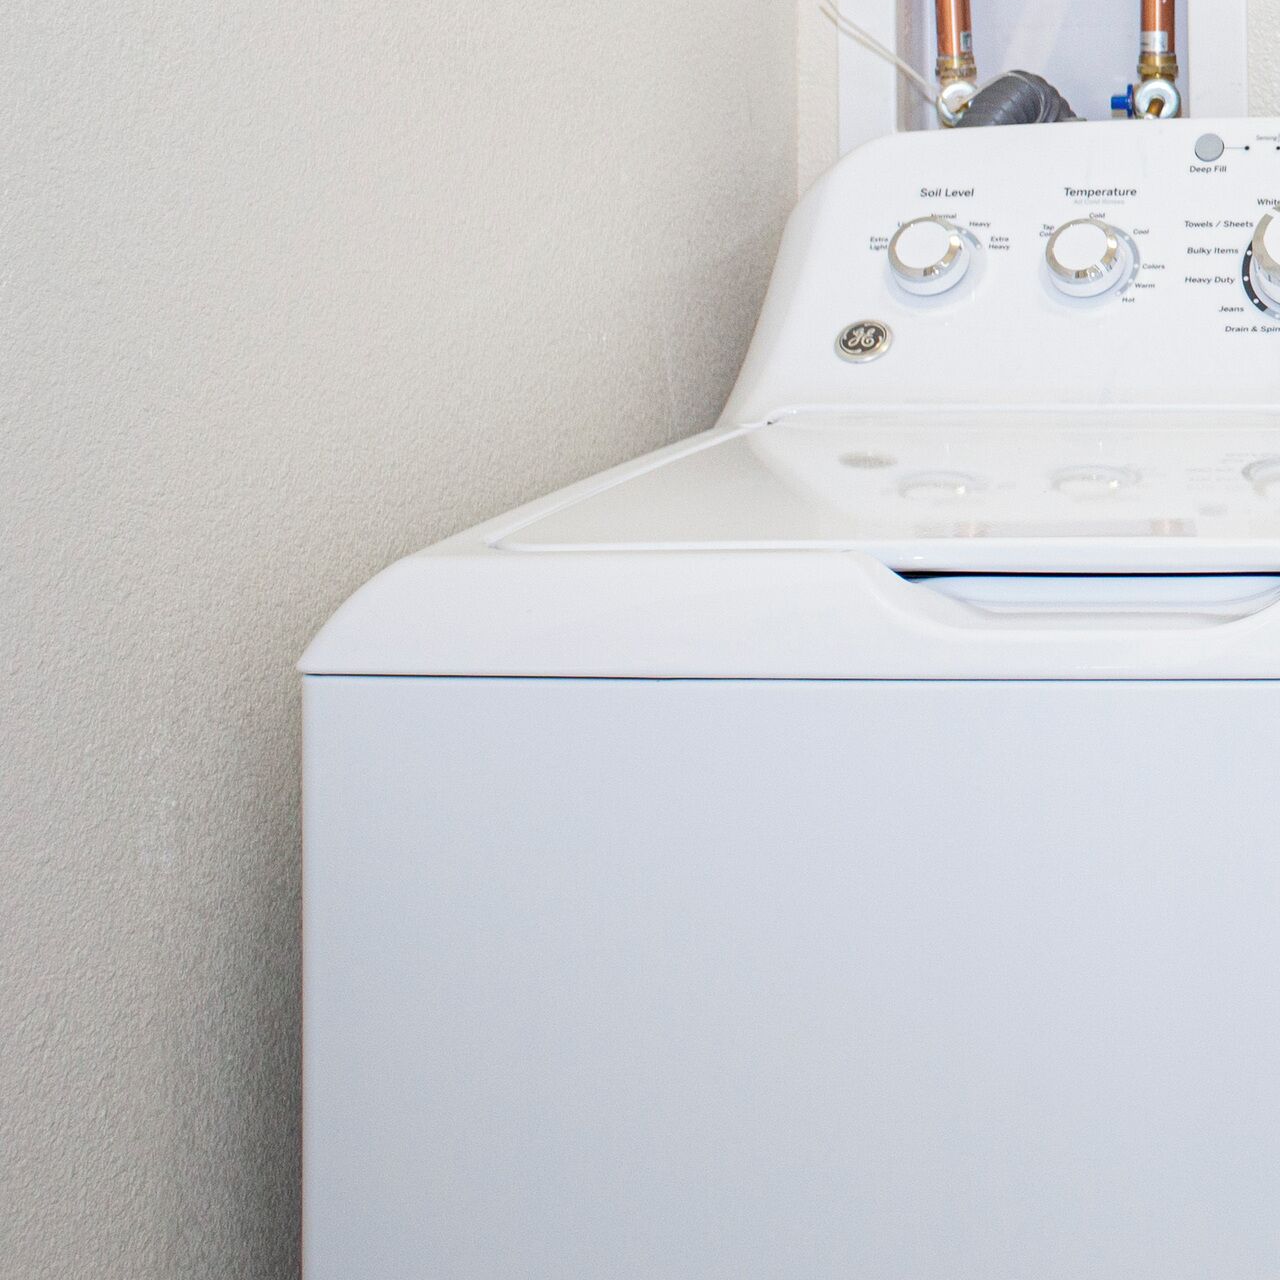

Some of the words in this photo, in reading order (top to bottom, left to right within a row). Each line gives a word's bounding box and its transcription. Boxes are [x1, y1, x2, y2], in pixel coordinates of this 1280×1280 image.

[920, 188, 941, 197] Soil
[945, 188, 974, 197] Level
[1064, 187, 1137, 198] Temperature
[1223, 220, 1253, 228] Sheets
[1187, 247, 1211, 255] Bulky
